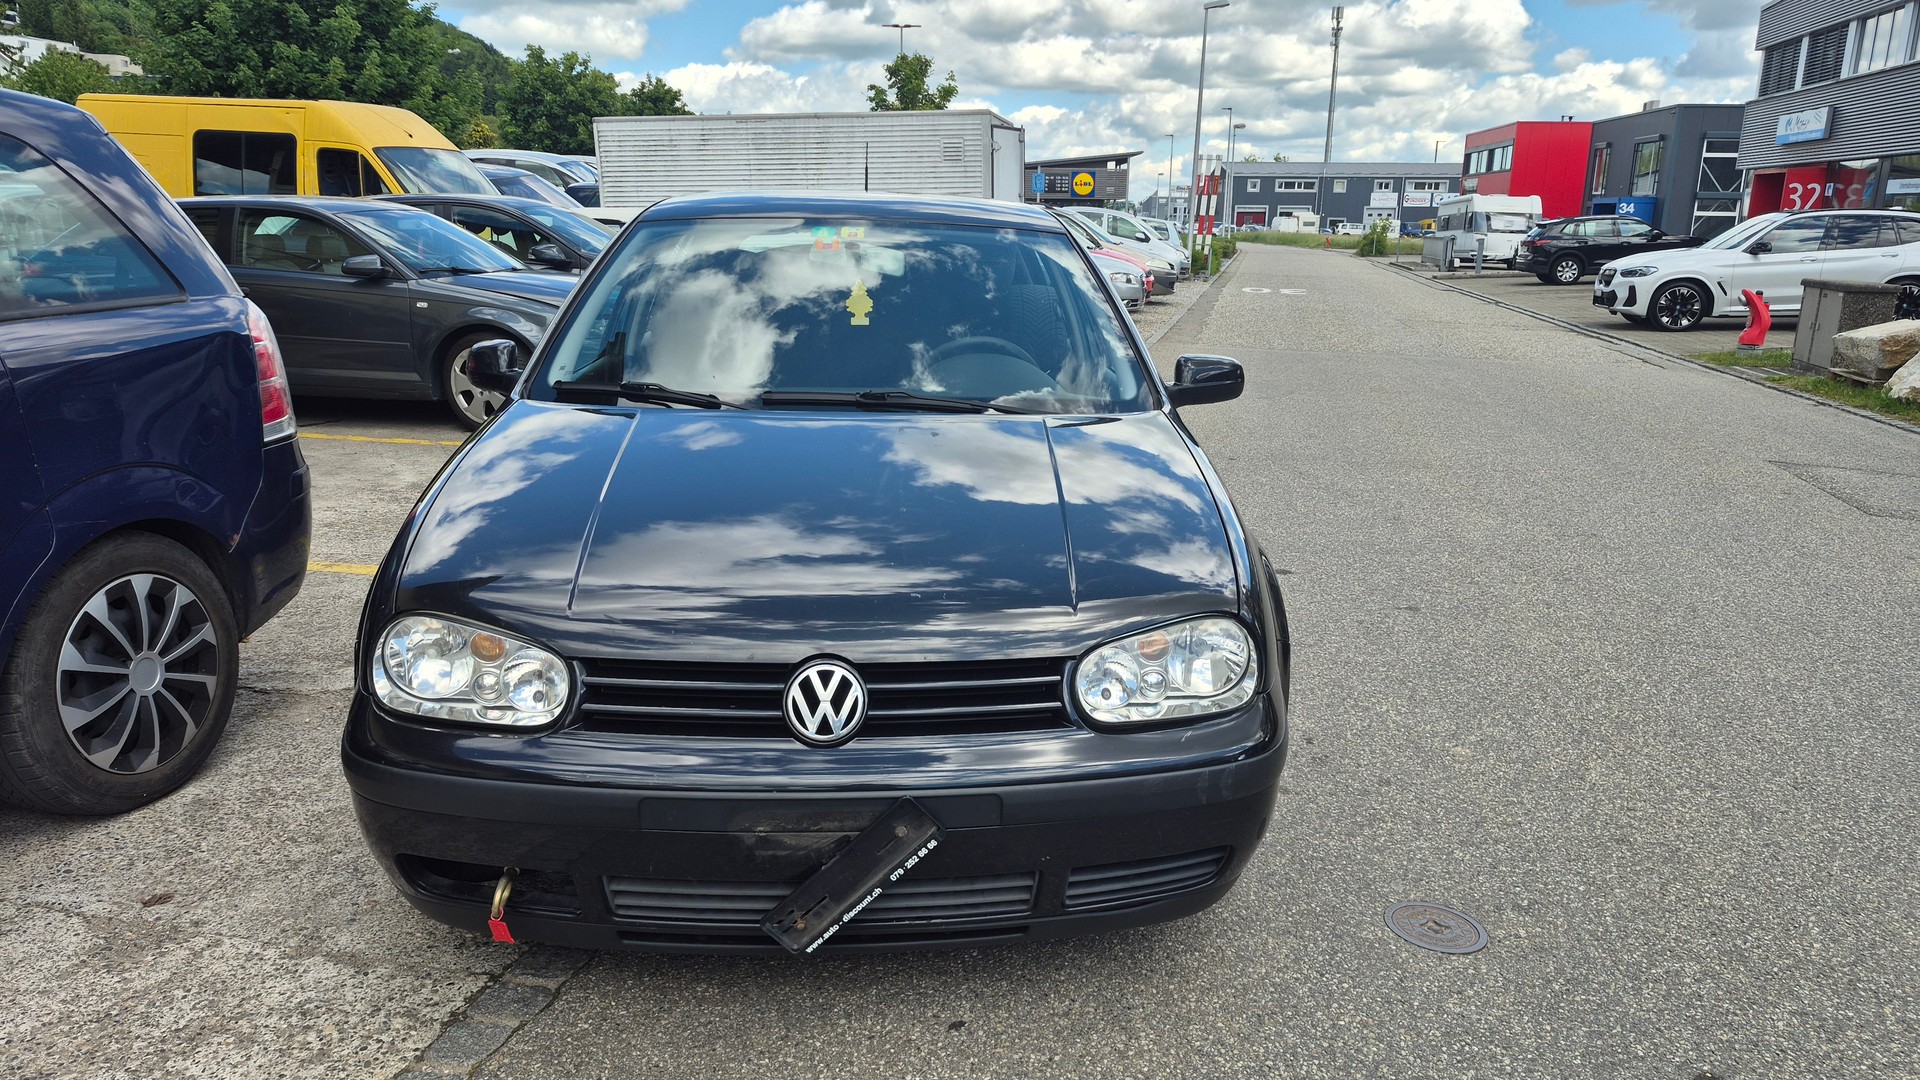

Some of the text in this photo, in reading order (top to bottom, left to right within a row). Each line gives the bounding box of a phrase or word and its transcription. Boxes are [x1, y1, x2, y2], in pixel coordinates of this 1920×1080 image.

[1074, 179, 1093, 188] LIDL
[1784, 182, 1821, 210] 32
[1619, 202, 1635, 214] 34
[805, 924, 839, 952] www.auto
[842, 887, 882, 922] discount.ch
[917, 847, 928, 857] 66
[926, 839, 937, 849] 66
